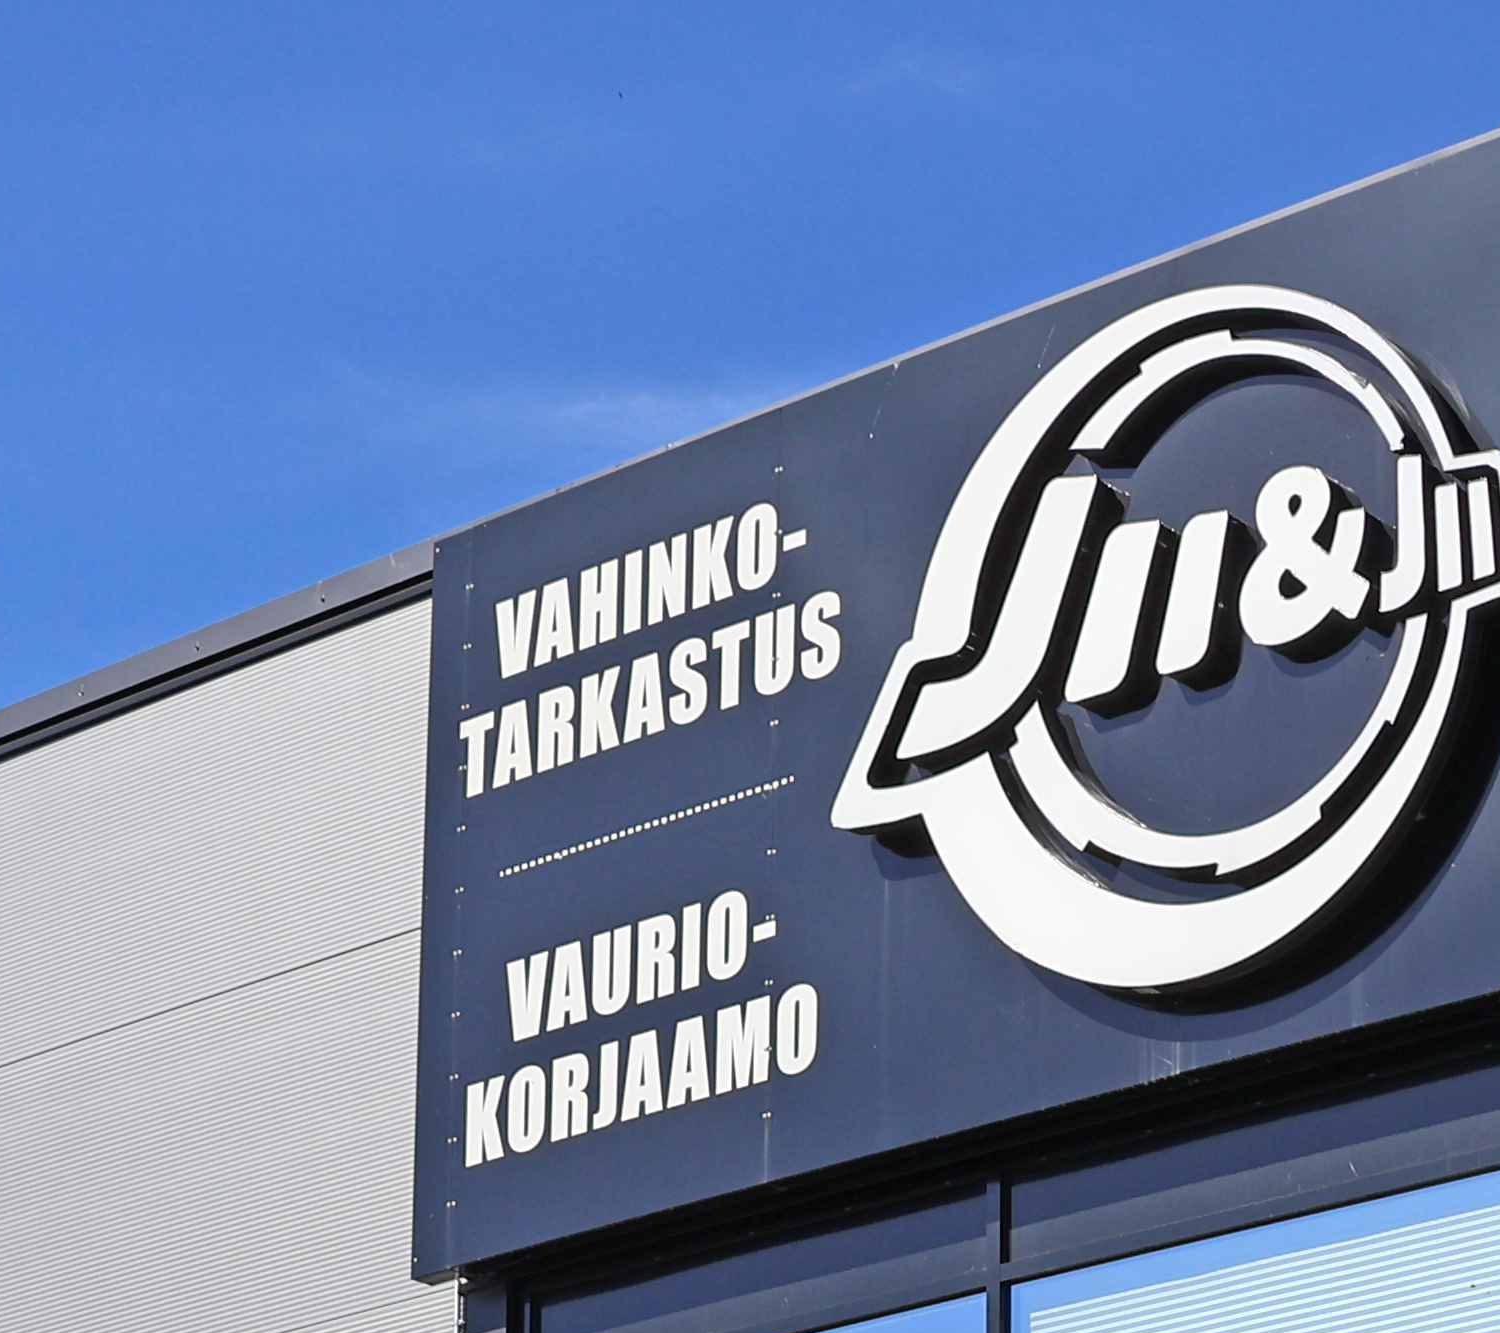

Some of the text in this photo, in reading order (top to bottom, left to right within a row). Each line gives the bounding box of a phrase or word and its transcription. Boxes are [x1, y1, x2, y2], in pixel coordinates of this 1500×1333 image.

[495, 502, 808, 680] VAHINKO-
[459, 590, 842, 799] TARKASTUS
[506, 890, 778, 1043] VAURIO-
[464, 982, 819, 1169] KORJAAMO
